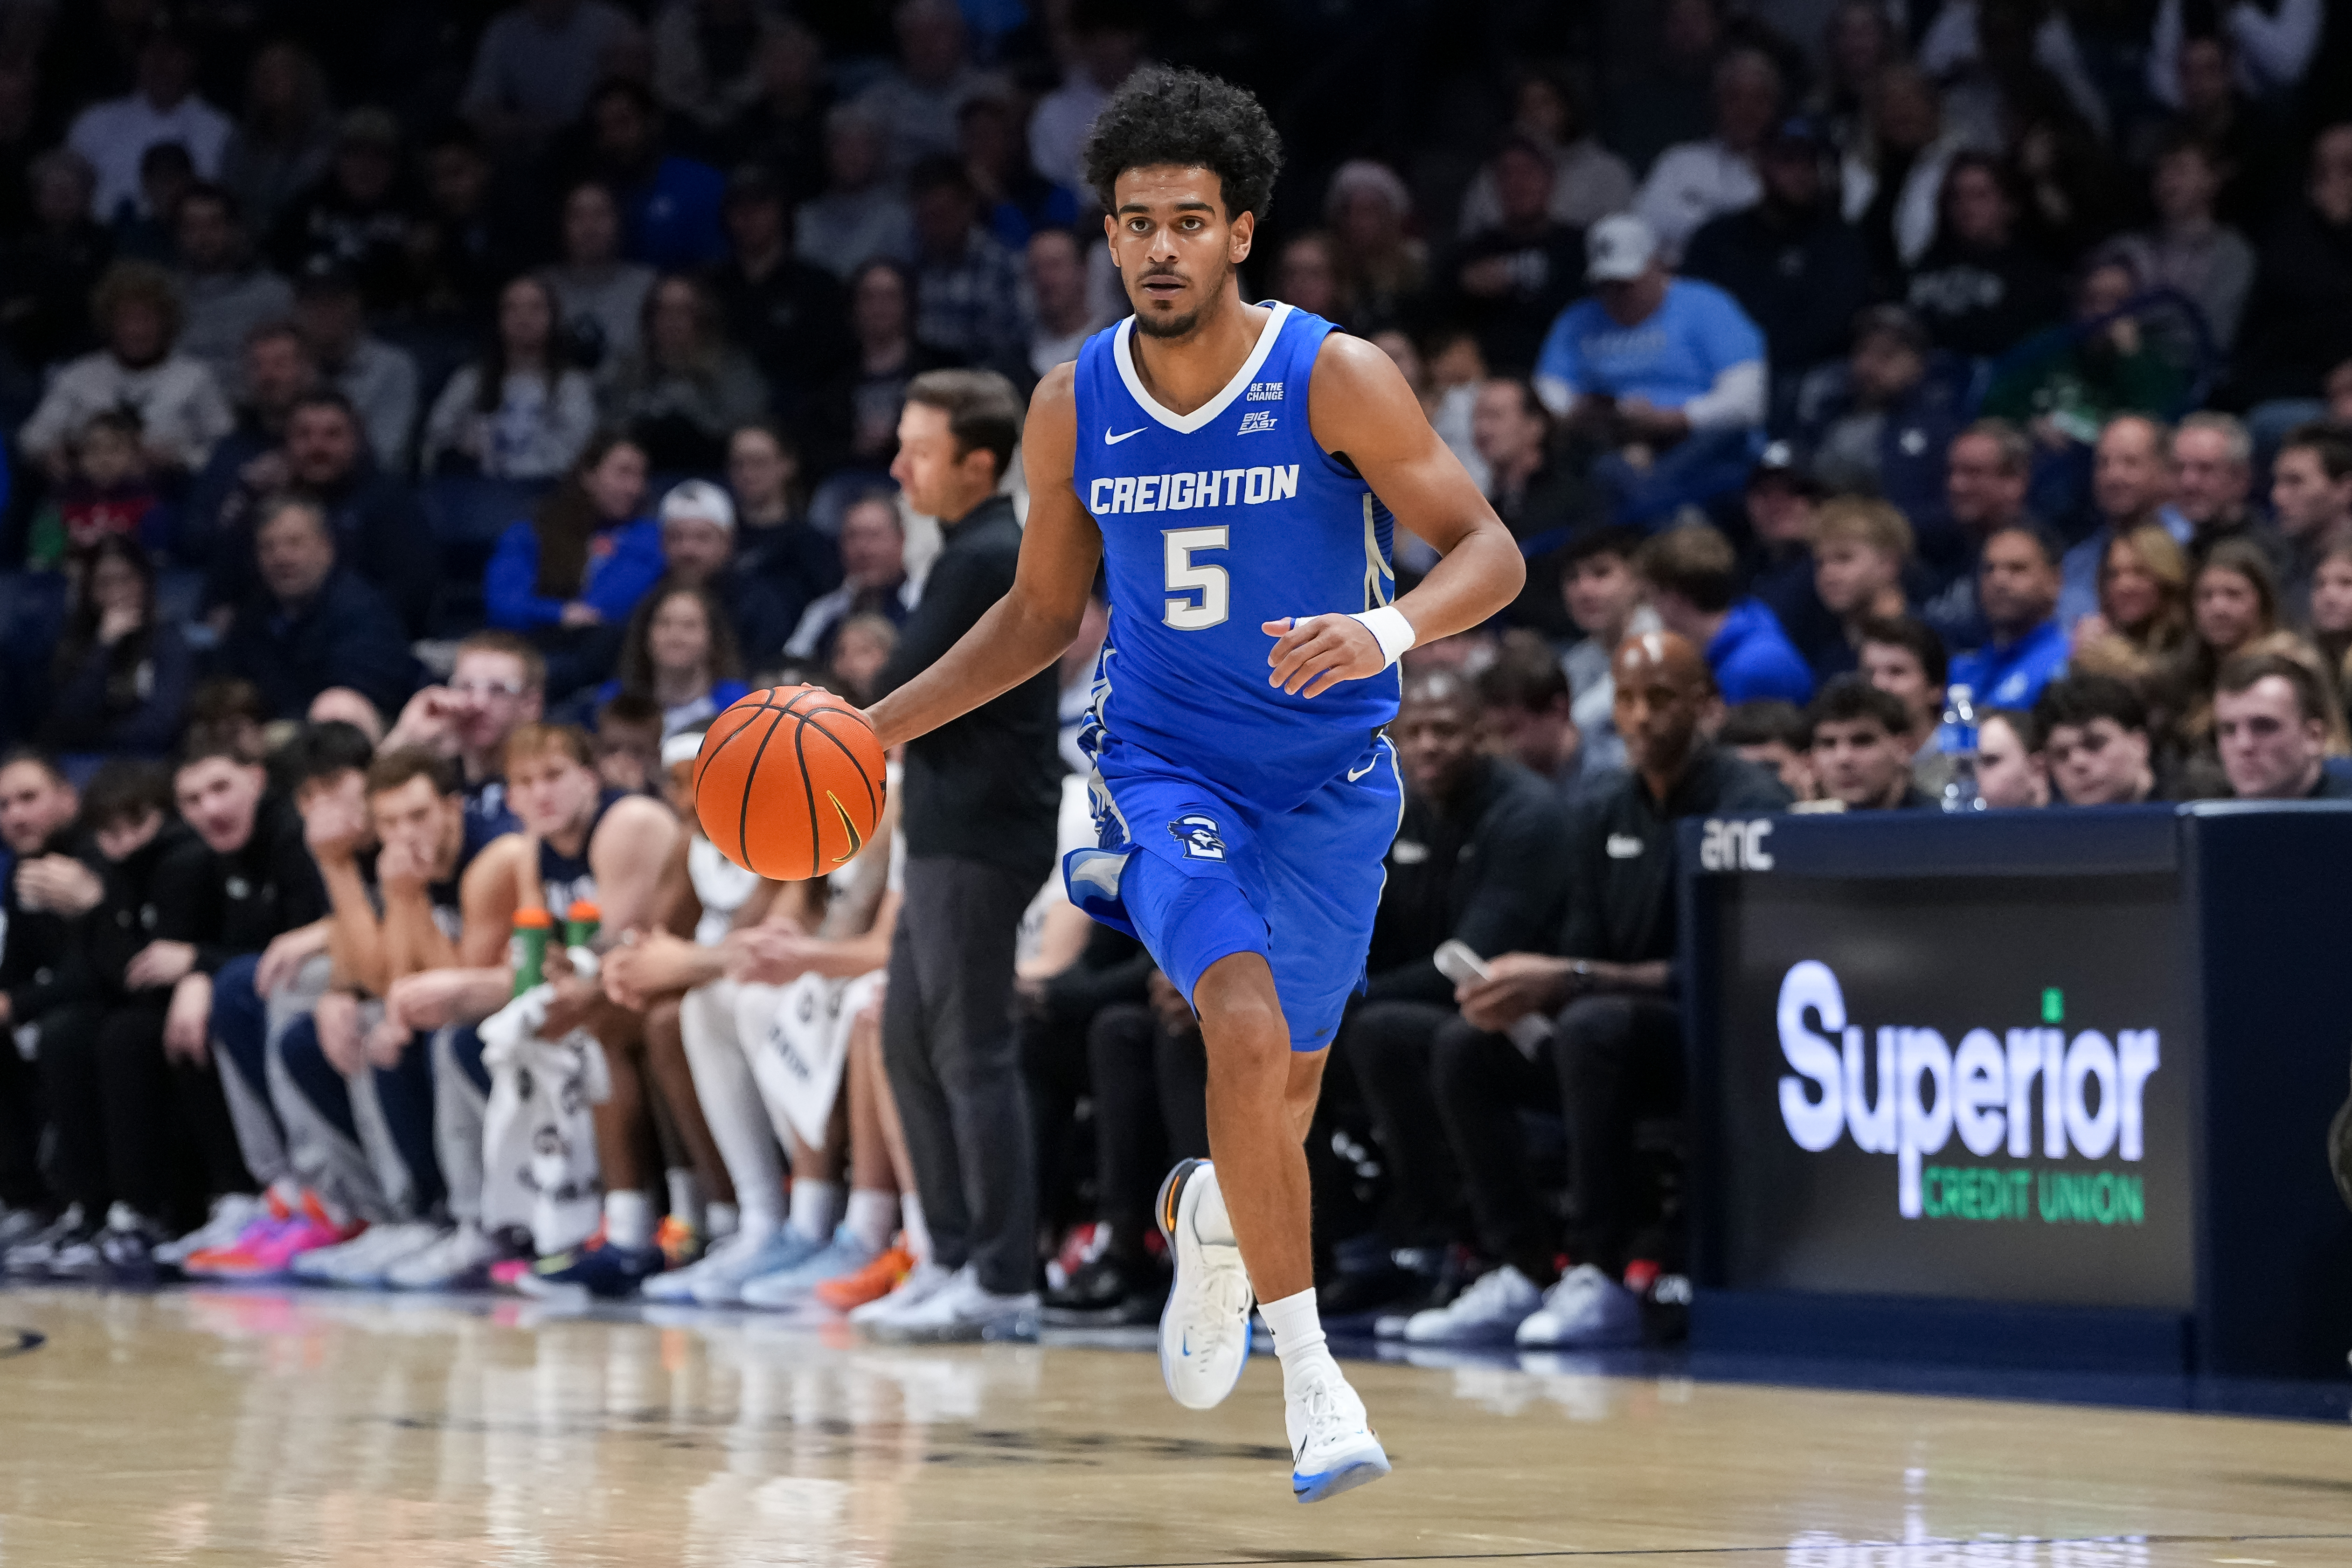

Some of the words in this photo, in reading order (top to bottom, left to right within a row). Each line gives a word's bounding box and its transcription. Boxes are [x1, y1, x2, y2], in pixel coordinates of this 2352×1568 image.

[1246, 391, 1284, 401] CHANGE
[1250, 382, 1263, 392] BE
[1265, 382, 1284, 391] THE
[1239, 419, 1278, 431] EAST
[1242, 410, 1270, 422] BIG
[1090, 464, 1300, 515] CREIGHTON
[1160, 525, 1229, 631] 5
[1700, 818, 1774, 871] anc
[1776, 959, 2161, 1220] Superior
[1922, 1166, 2032, 1220] CREDIT
[2038, 1170, 2144, 1225] UNION
